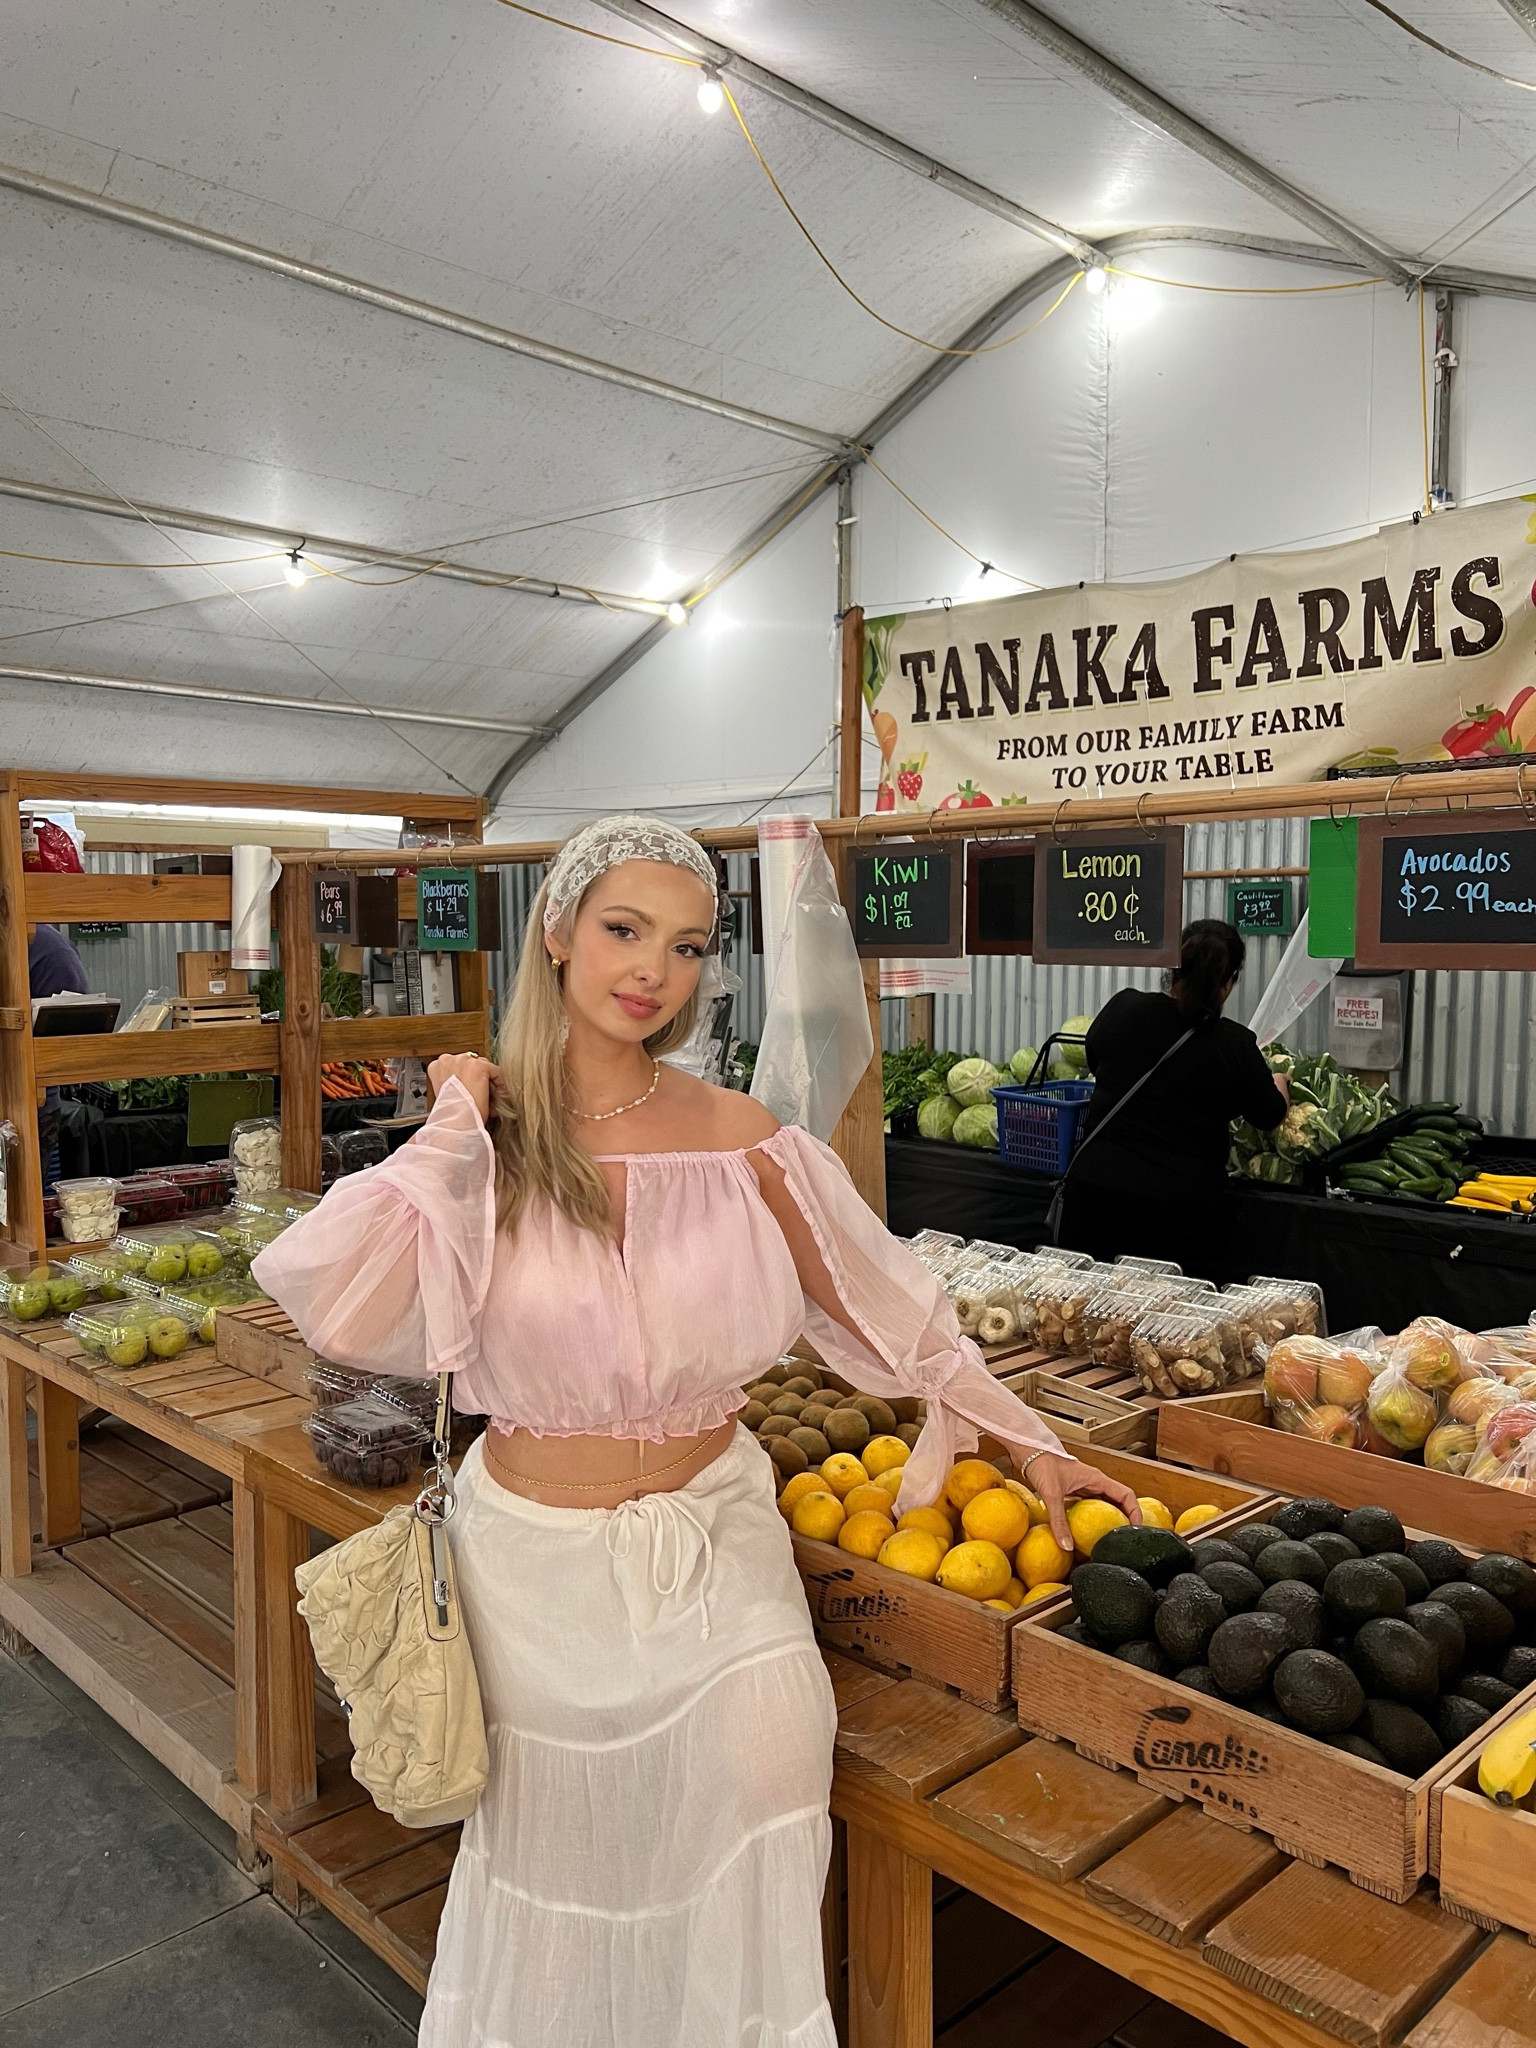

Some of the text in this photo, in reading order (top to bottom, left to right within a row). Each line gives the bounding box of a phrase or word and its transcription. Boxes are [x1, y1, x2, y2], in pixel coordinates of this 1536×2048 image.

[900, 556, 1504, 724] TANAKA FARMS
[996, 701, 1345, 761] FROM OUR FAMILY FARM
[1052, 748, 1274, 789] TO YOUR TABLE
[1062, 850, 1141, 880] Lemon
[1400, 847, 1511, 876] Avocados
[320, 881, 341, 900] Pears
[422, 879, 469, 899] Blackberries
[1237, 891, 1280, 900] Cauliflower
[1398, 879, 1536, 917] $2.99 each
[320, 901, 344, 924] $6.99
[865, 891, 909, 926] $1.09
[424, 925, 469, 939] Tanaka Farms
[895, 914, 914, 930] ea.
[1114, 926, 1145, 942] each
[1337, 1009, 1378, 1019] RECIPES!
[1346, 999, 1369, 1009] FREE
[1190, 1778, 1259, 1819] FARMS
